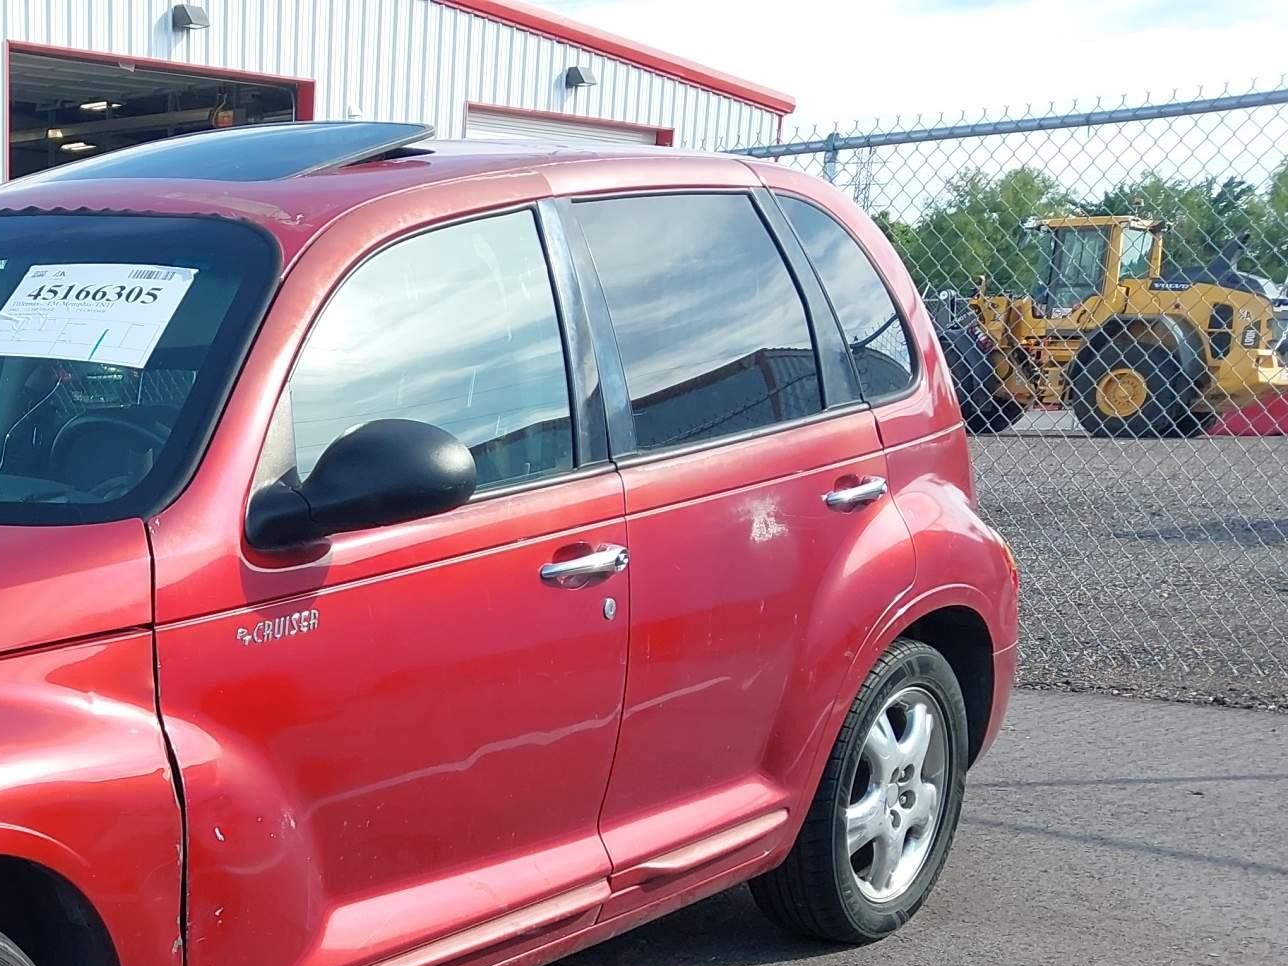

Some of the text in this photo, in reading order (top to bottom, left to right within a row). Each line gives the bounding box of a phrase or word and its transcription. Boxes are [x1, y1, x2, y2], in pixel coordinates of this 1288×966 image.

[26, 284, 163, 306] 45166305
[237, 610, 319, 646] PT CRUISER
